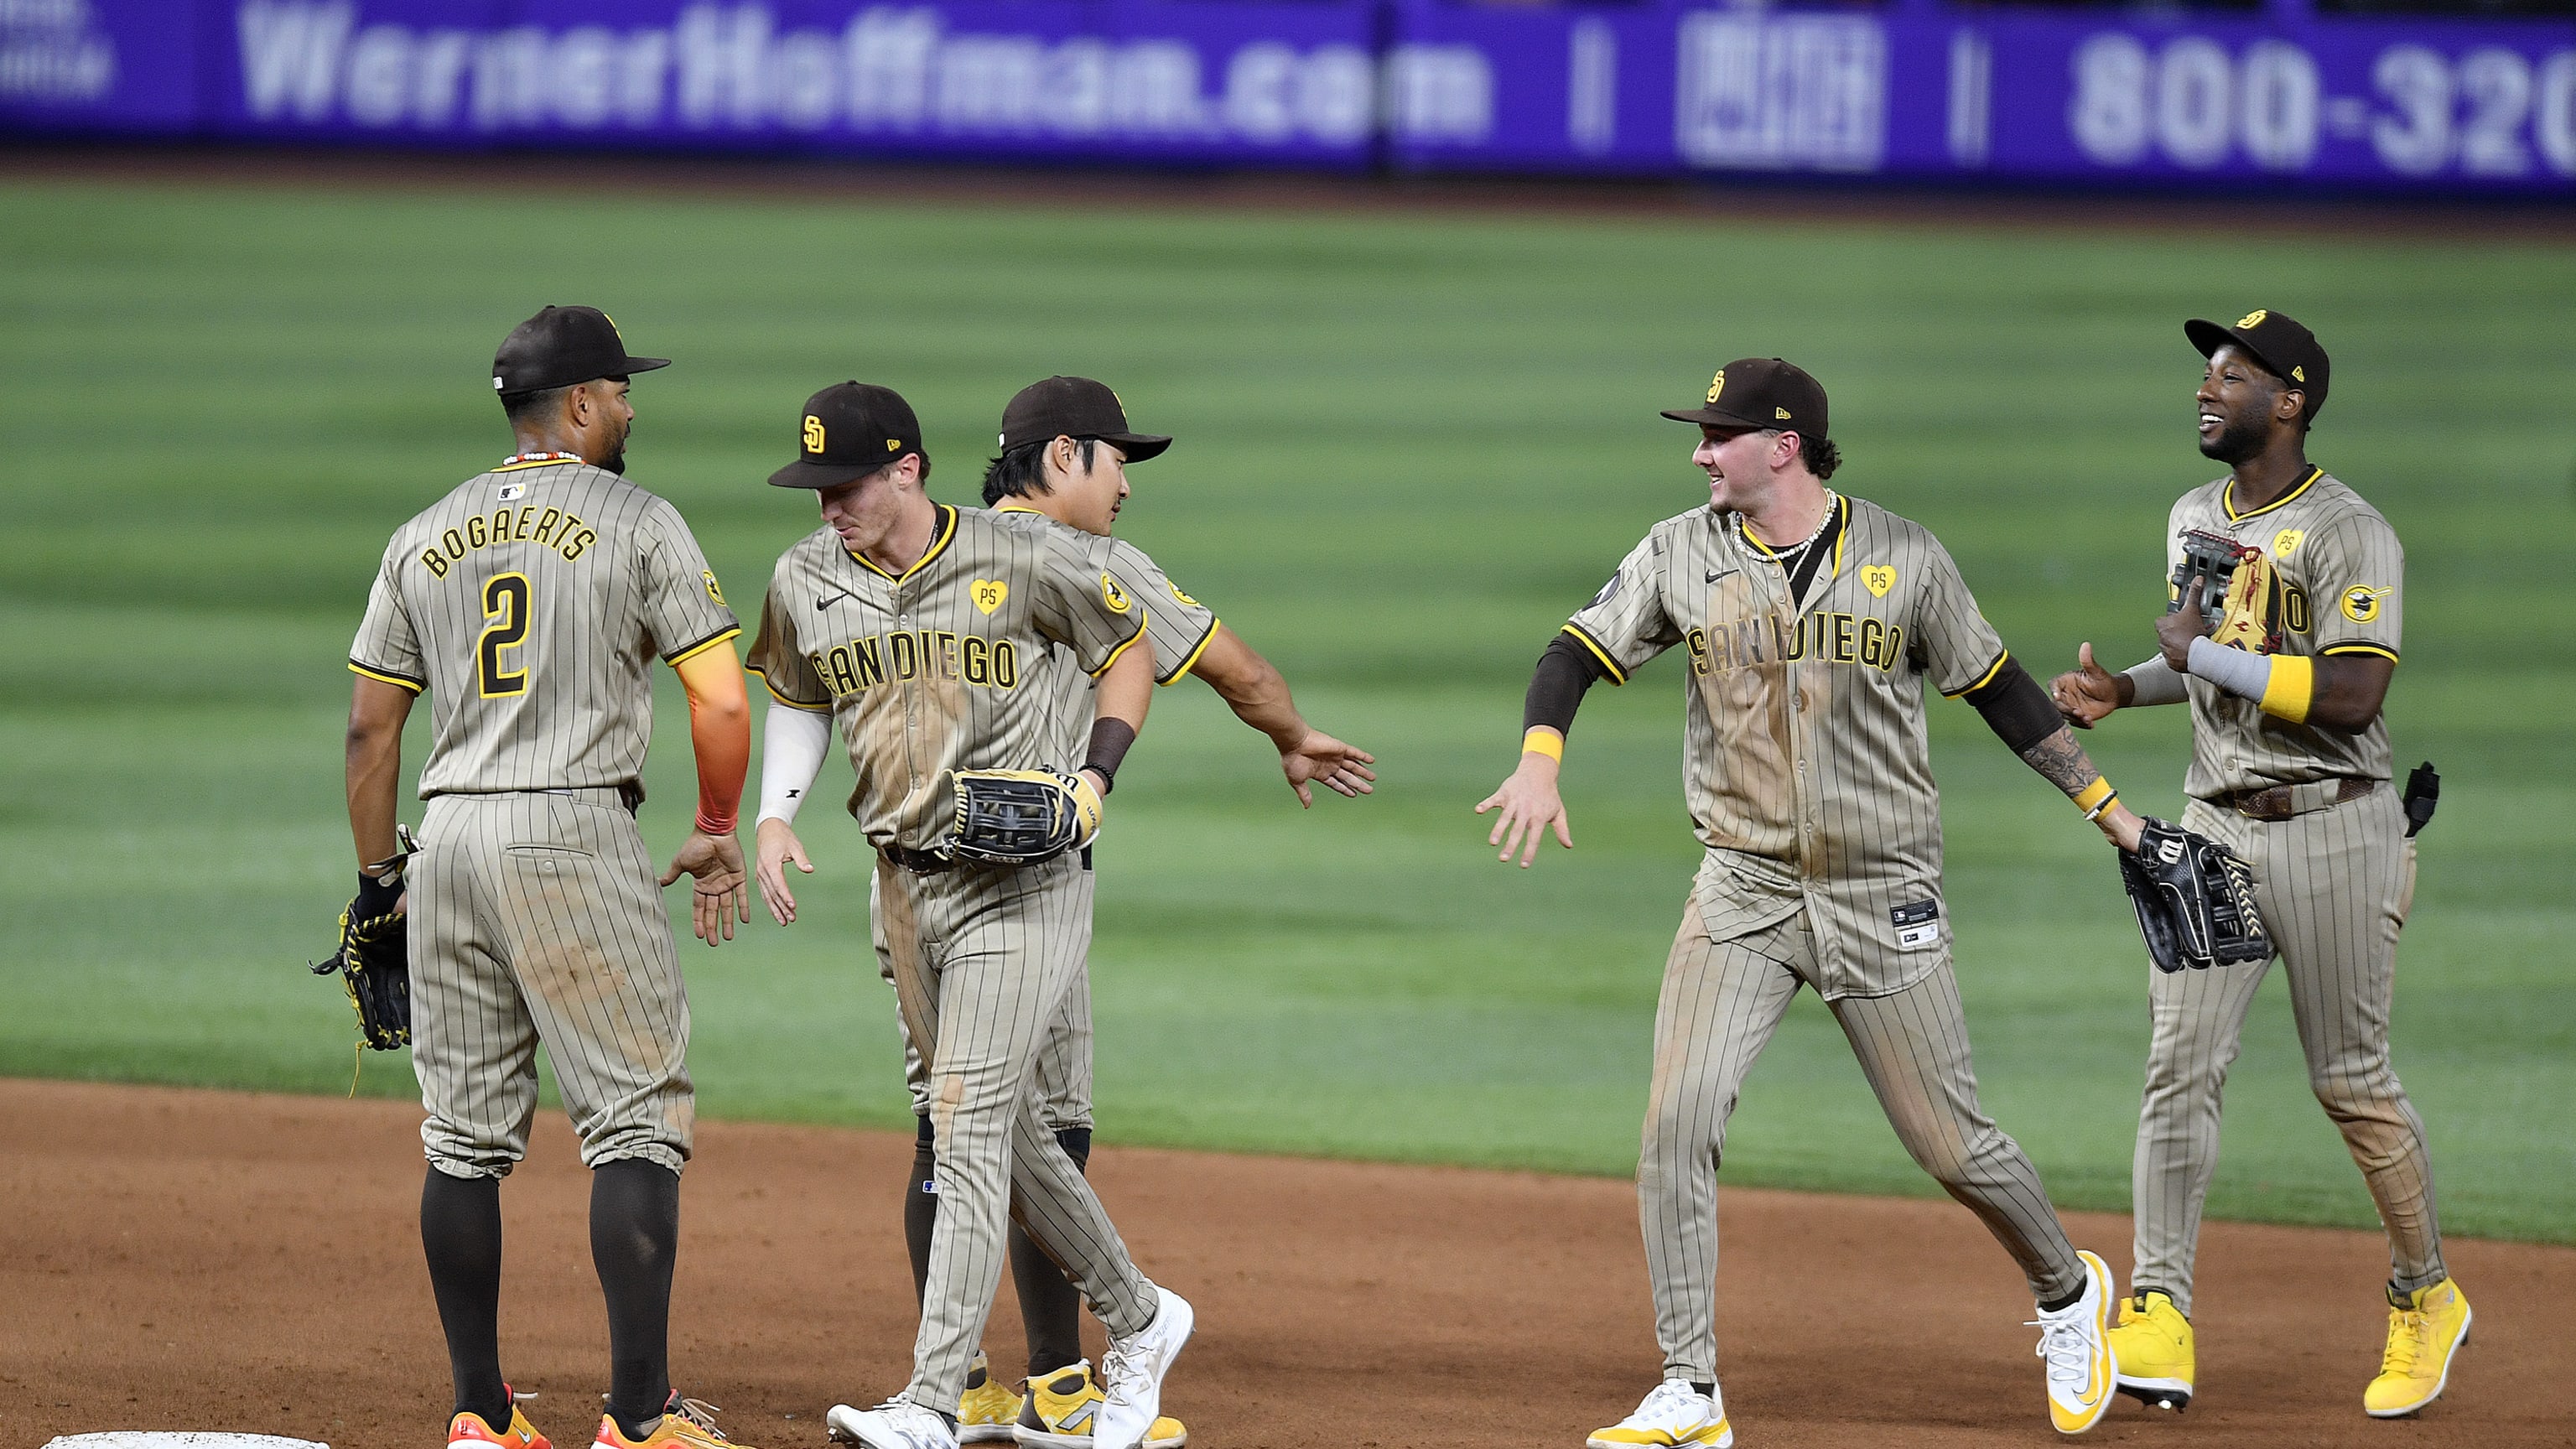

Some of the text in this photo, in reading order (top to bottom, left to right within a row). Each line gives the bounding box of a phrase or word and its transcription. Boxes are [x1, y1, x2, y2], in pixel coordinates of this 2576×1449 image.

[238, 0, 1494, 144] WernerHoffman.com
[803, 415, 826, 454] SD
[421, 506, 596, 579] BOGAERTS
[2277, 535, 2295, 551] PS
[979, 588, 997, 605] PS
[1871, 572, 1886, 589] PS
[476, 571, 532, 699] 2
[811, 630, 1019, 698] SAN DIEGO
[1686, 611, 1903, 677] SAN DIEGO
